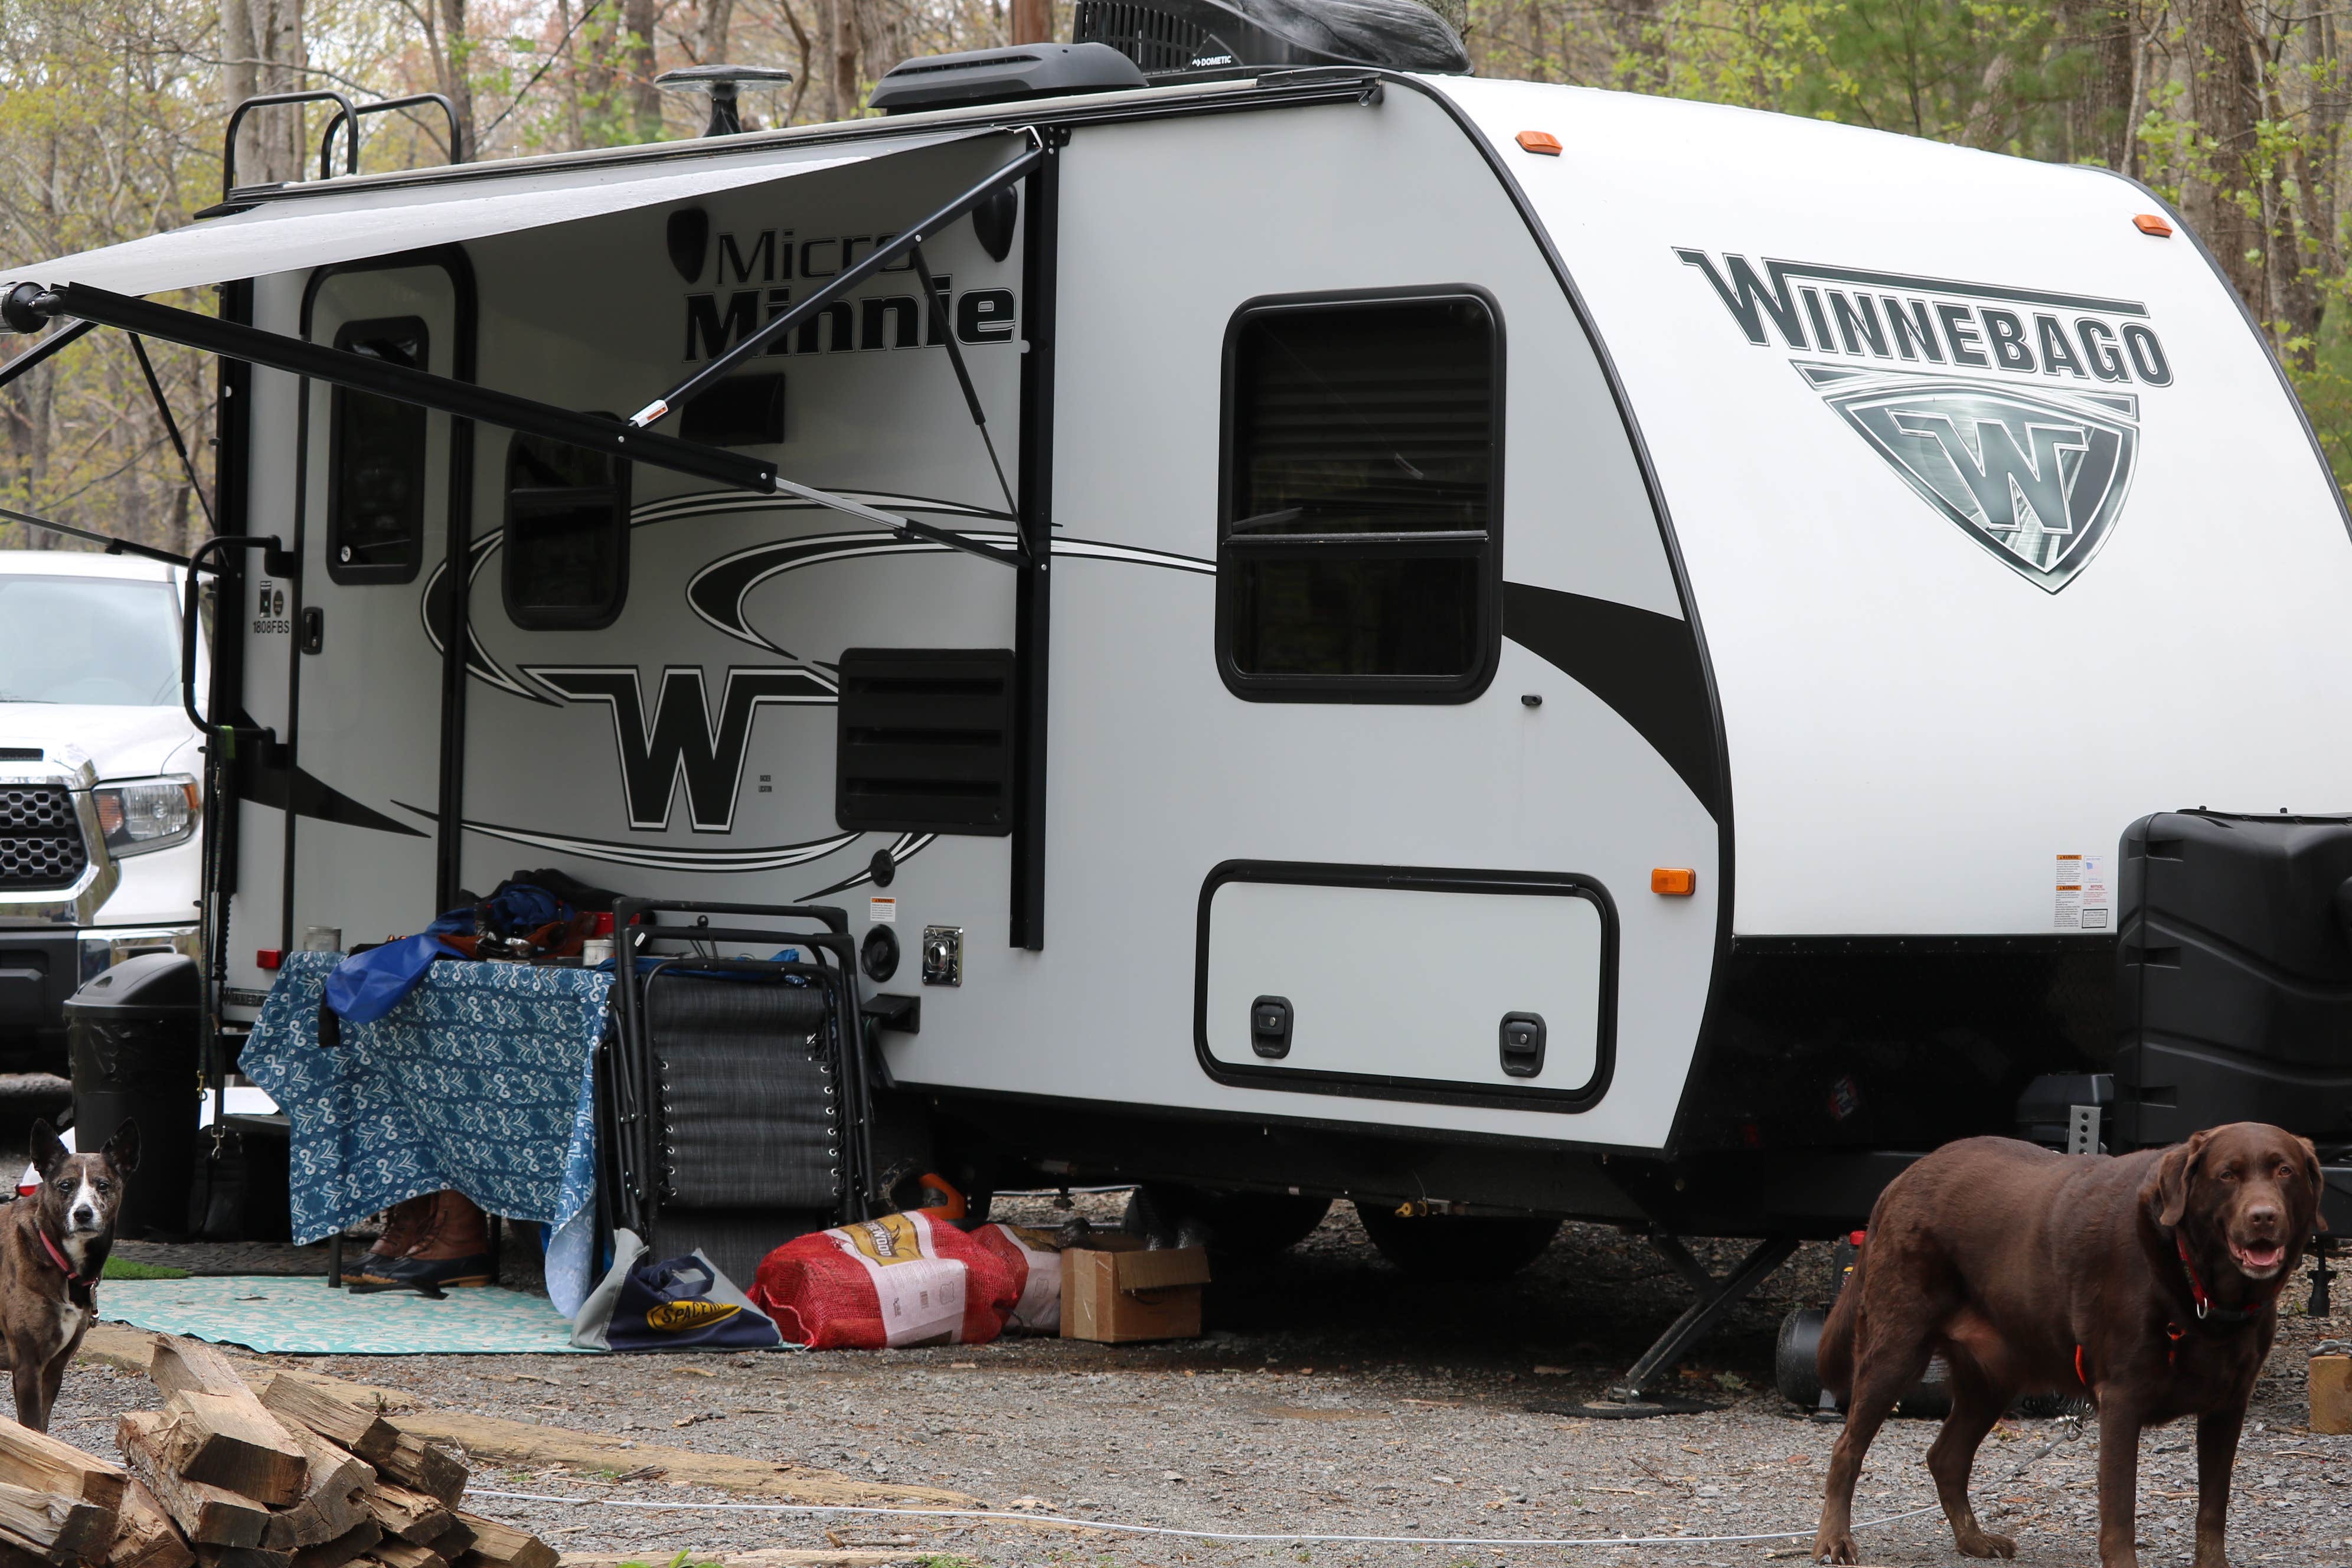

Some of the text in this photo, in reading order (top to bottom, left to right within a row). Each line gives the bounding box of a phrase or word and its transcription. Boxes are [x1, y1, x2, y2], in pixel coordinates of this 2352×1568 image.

[1201, 55, 1231, 66] DOMETIC
[682, 274, 1016, 363] Minnie
[1671, 246, 2173, 387] WINNEBAGO
[253, 620, 290, 633] 1808FBS
